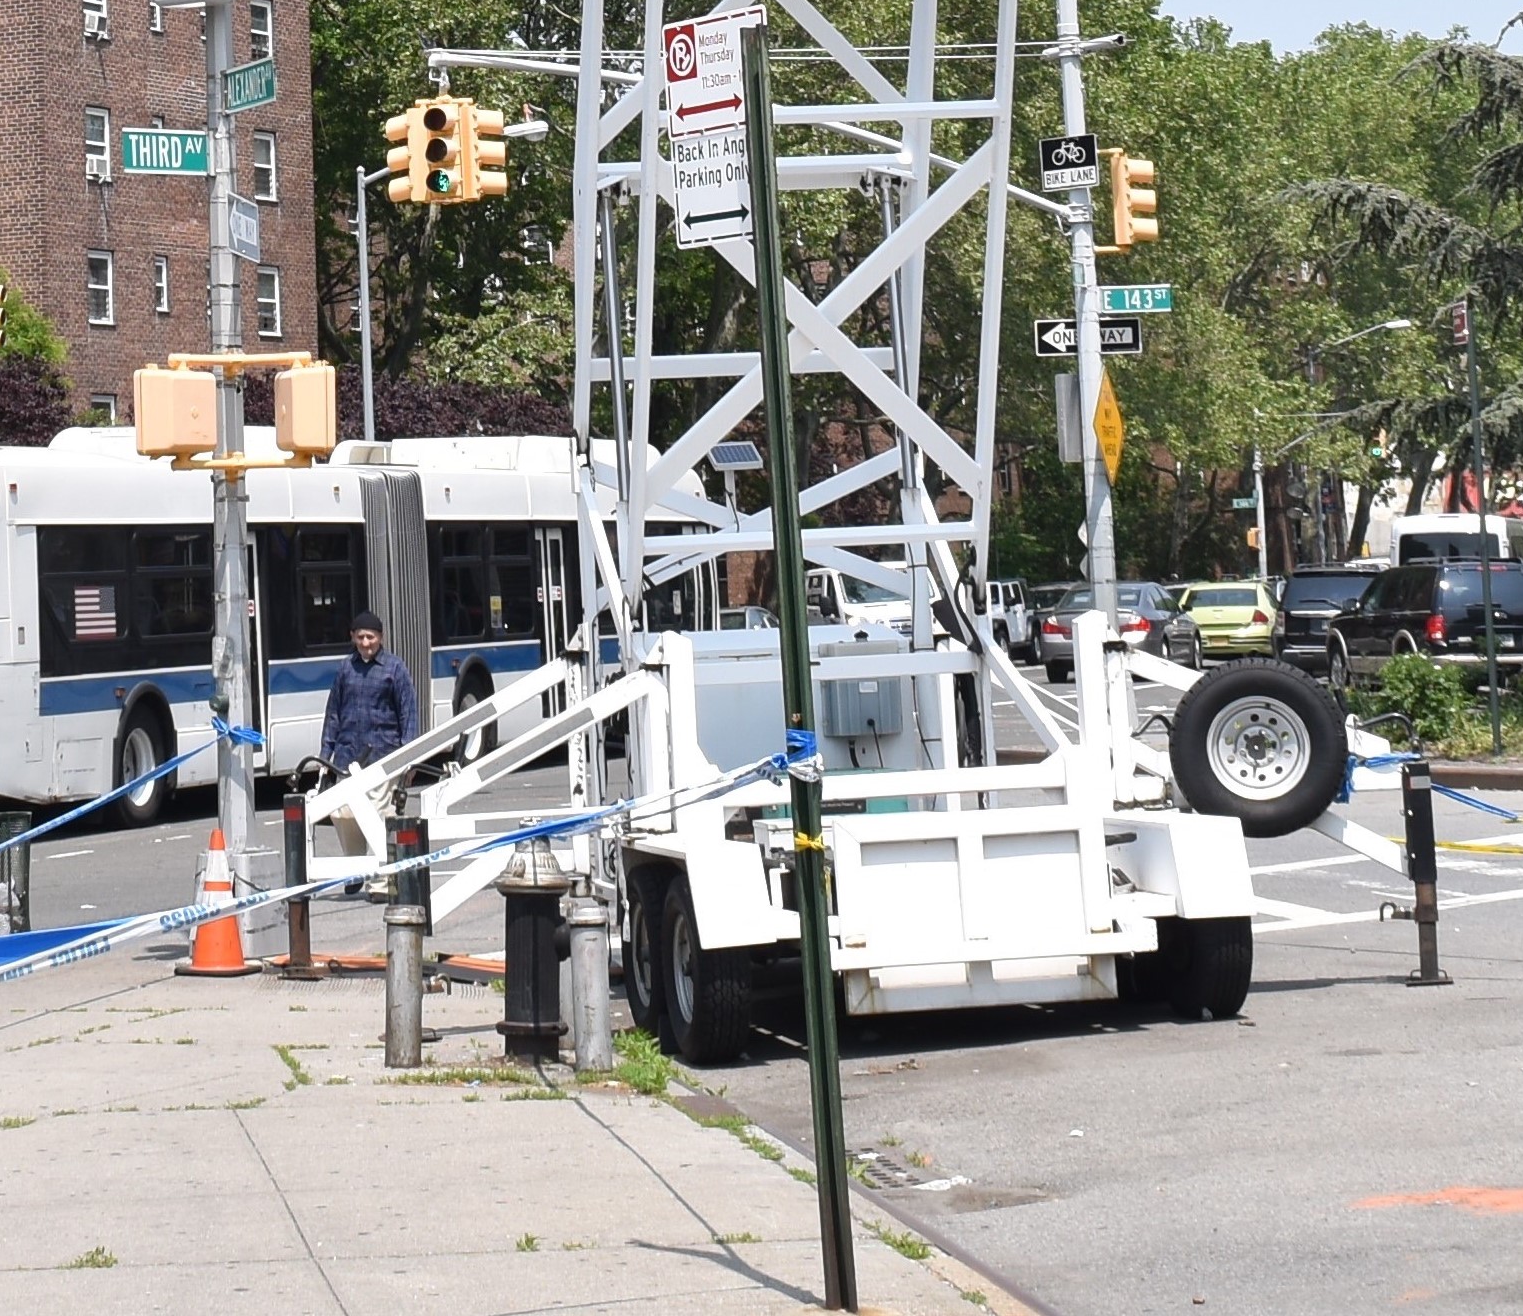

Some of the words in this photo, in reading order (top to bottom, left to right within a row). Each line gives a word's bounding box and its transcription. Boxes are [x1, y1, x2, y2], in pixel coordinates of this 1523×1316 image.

[698, 30, 728, 47] Monday
[700, 46, 735, 65] Thursday
[227, 66, 267, 109] ALEXANDER
[128, 134, 183, 168] THIRD
[184, 136, 203, 154] AV
[677, 140, 705, 163] Back
[708, 138, 719, 158] In
[723, 136, 745, 158] Ang
[679, 167, 722, 189] Parking
[1045, 171, 1066, 186] BIKE
[1070, 168, 1095, 183] LANE
[1103, 291, 1112, 309] E
[1124, 289, 1153, 309] 143
[1154, 289, 1167, 300] ST
